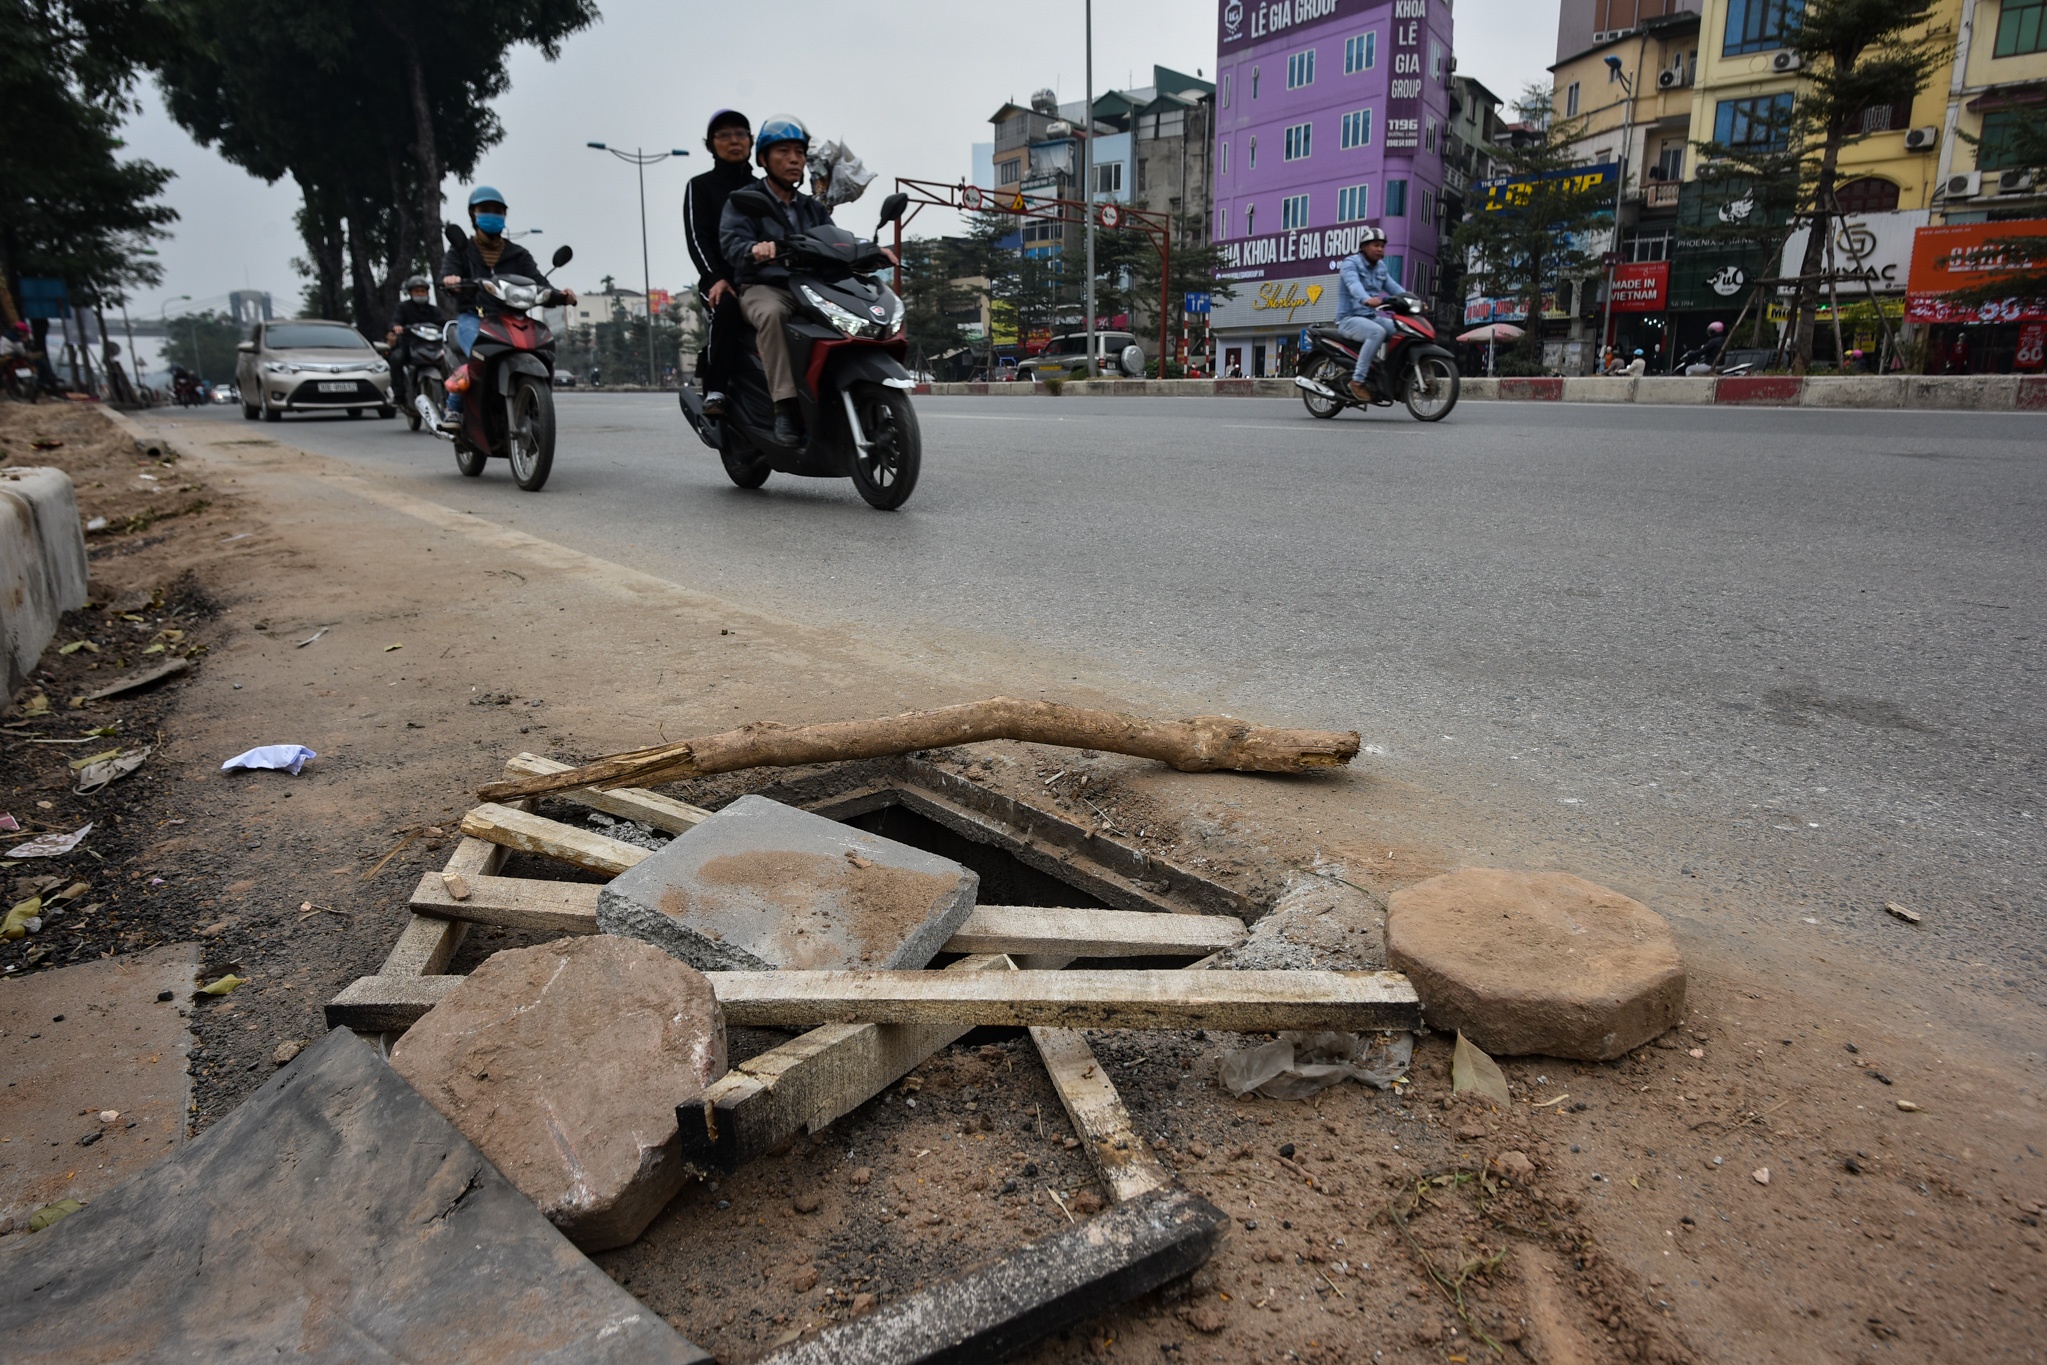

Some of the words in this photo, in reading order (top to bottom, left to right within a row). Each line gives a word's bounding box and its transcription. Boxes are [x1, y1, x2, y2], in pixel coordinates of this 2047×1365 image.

[1251, 1, 1268, 39] LÊ
[1270, 0, 1292, 33] GIA
[1398, 21, 1418, 46] LÊ
[1395, 53, 1420, 74] GIA
[1391, 79, 1421, 99] GROUP
[1388, 119, 1418, 131] 1196
[1243, 235, 1277, 267] KHOA
[1279, 230, 1297, 263] LÊ
[1299, 231, 1322, 260] GIA
[1612, 279, 1642, 290] MADE
[1643, 277, 1656, 289] IN
[1610, 289, 1658, 302] VIETNAM
